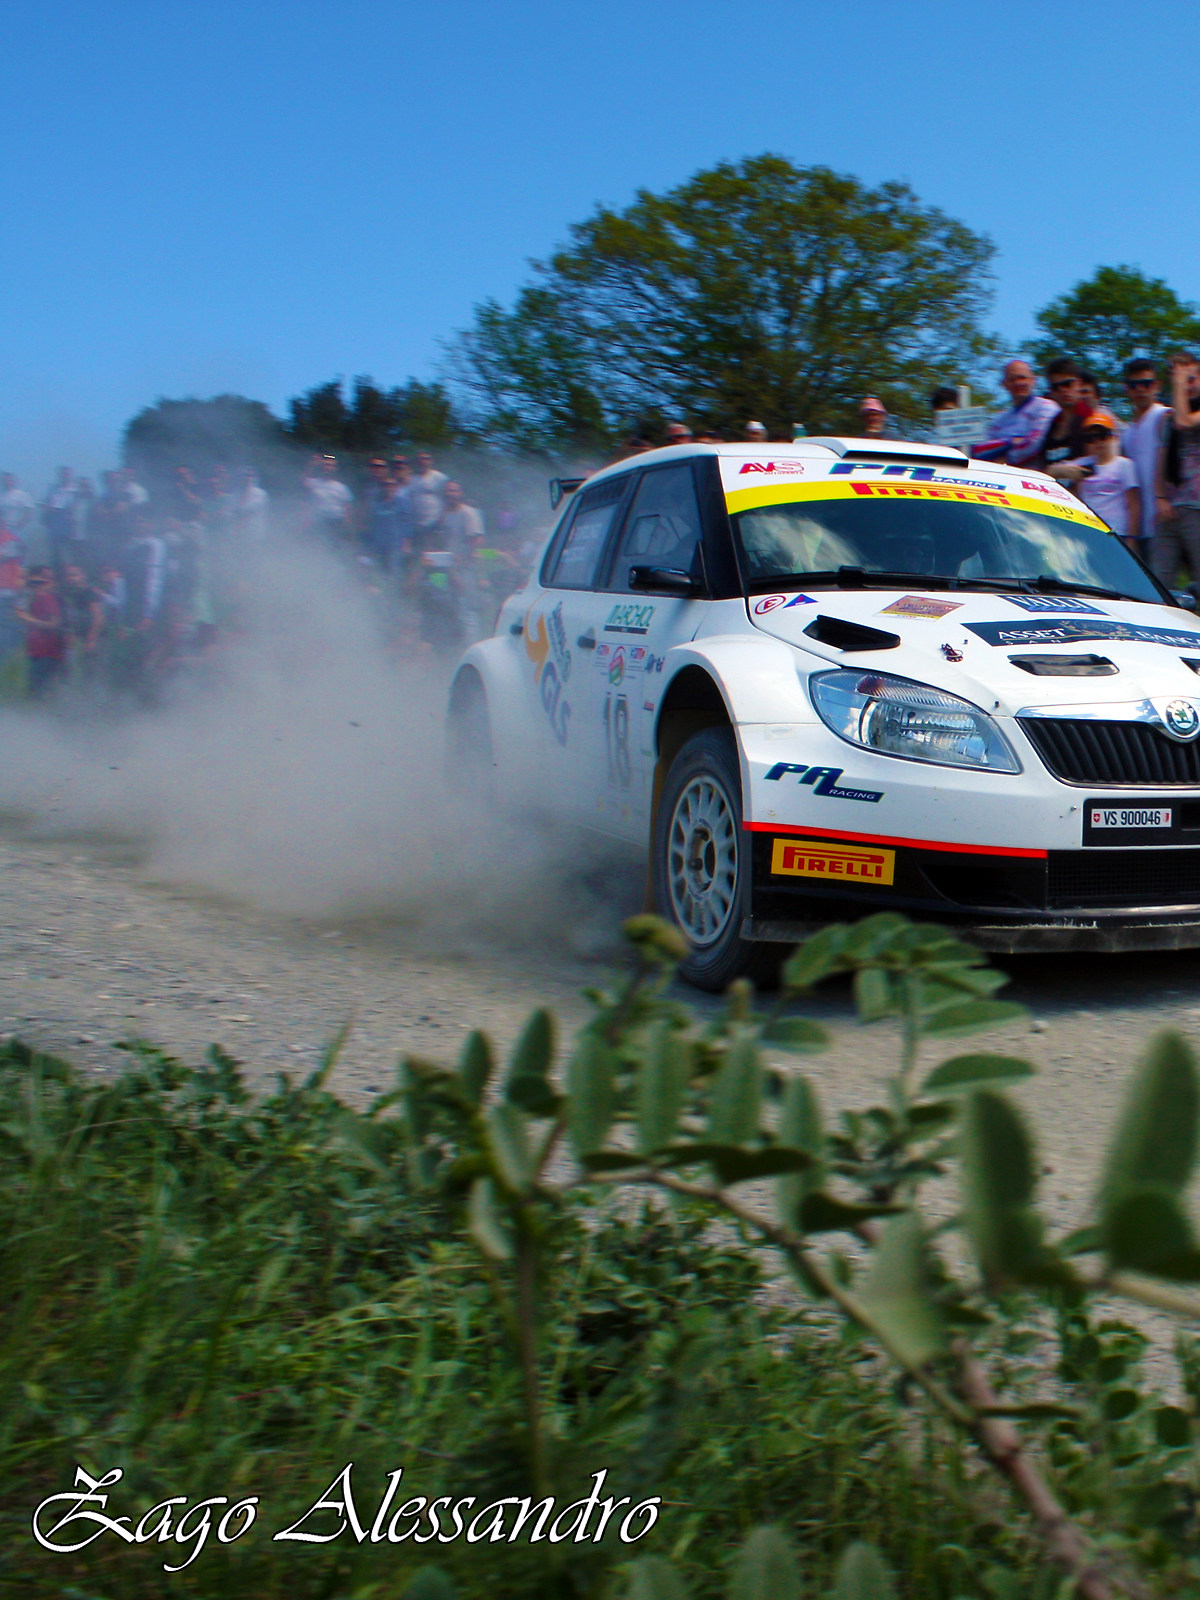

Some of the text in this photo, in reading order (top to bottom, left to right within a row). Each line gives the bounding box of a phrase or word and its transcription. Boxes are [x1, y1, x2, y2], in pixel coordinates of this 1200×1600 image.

[739, 460, 805, 475] AVS
[930, 476, 1000, 490] RACING
[849, 482, 1011, 506] PIRELLI
[998, 628, 1066, 641] ASSET
[828, 788, 876, 800] RACING
[1103, 810, 1161, 826] VS 900046
[783, 846, 885, 878] PIRELLI
